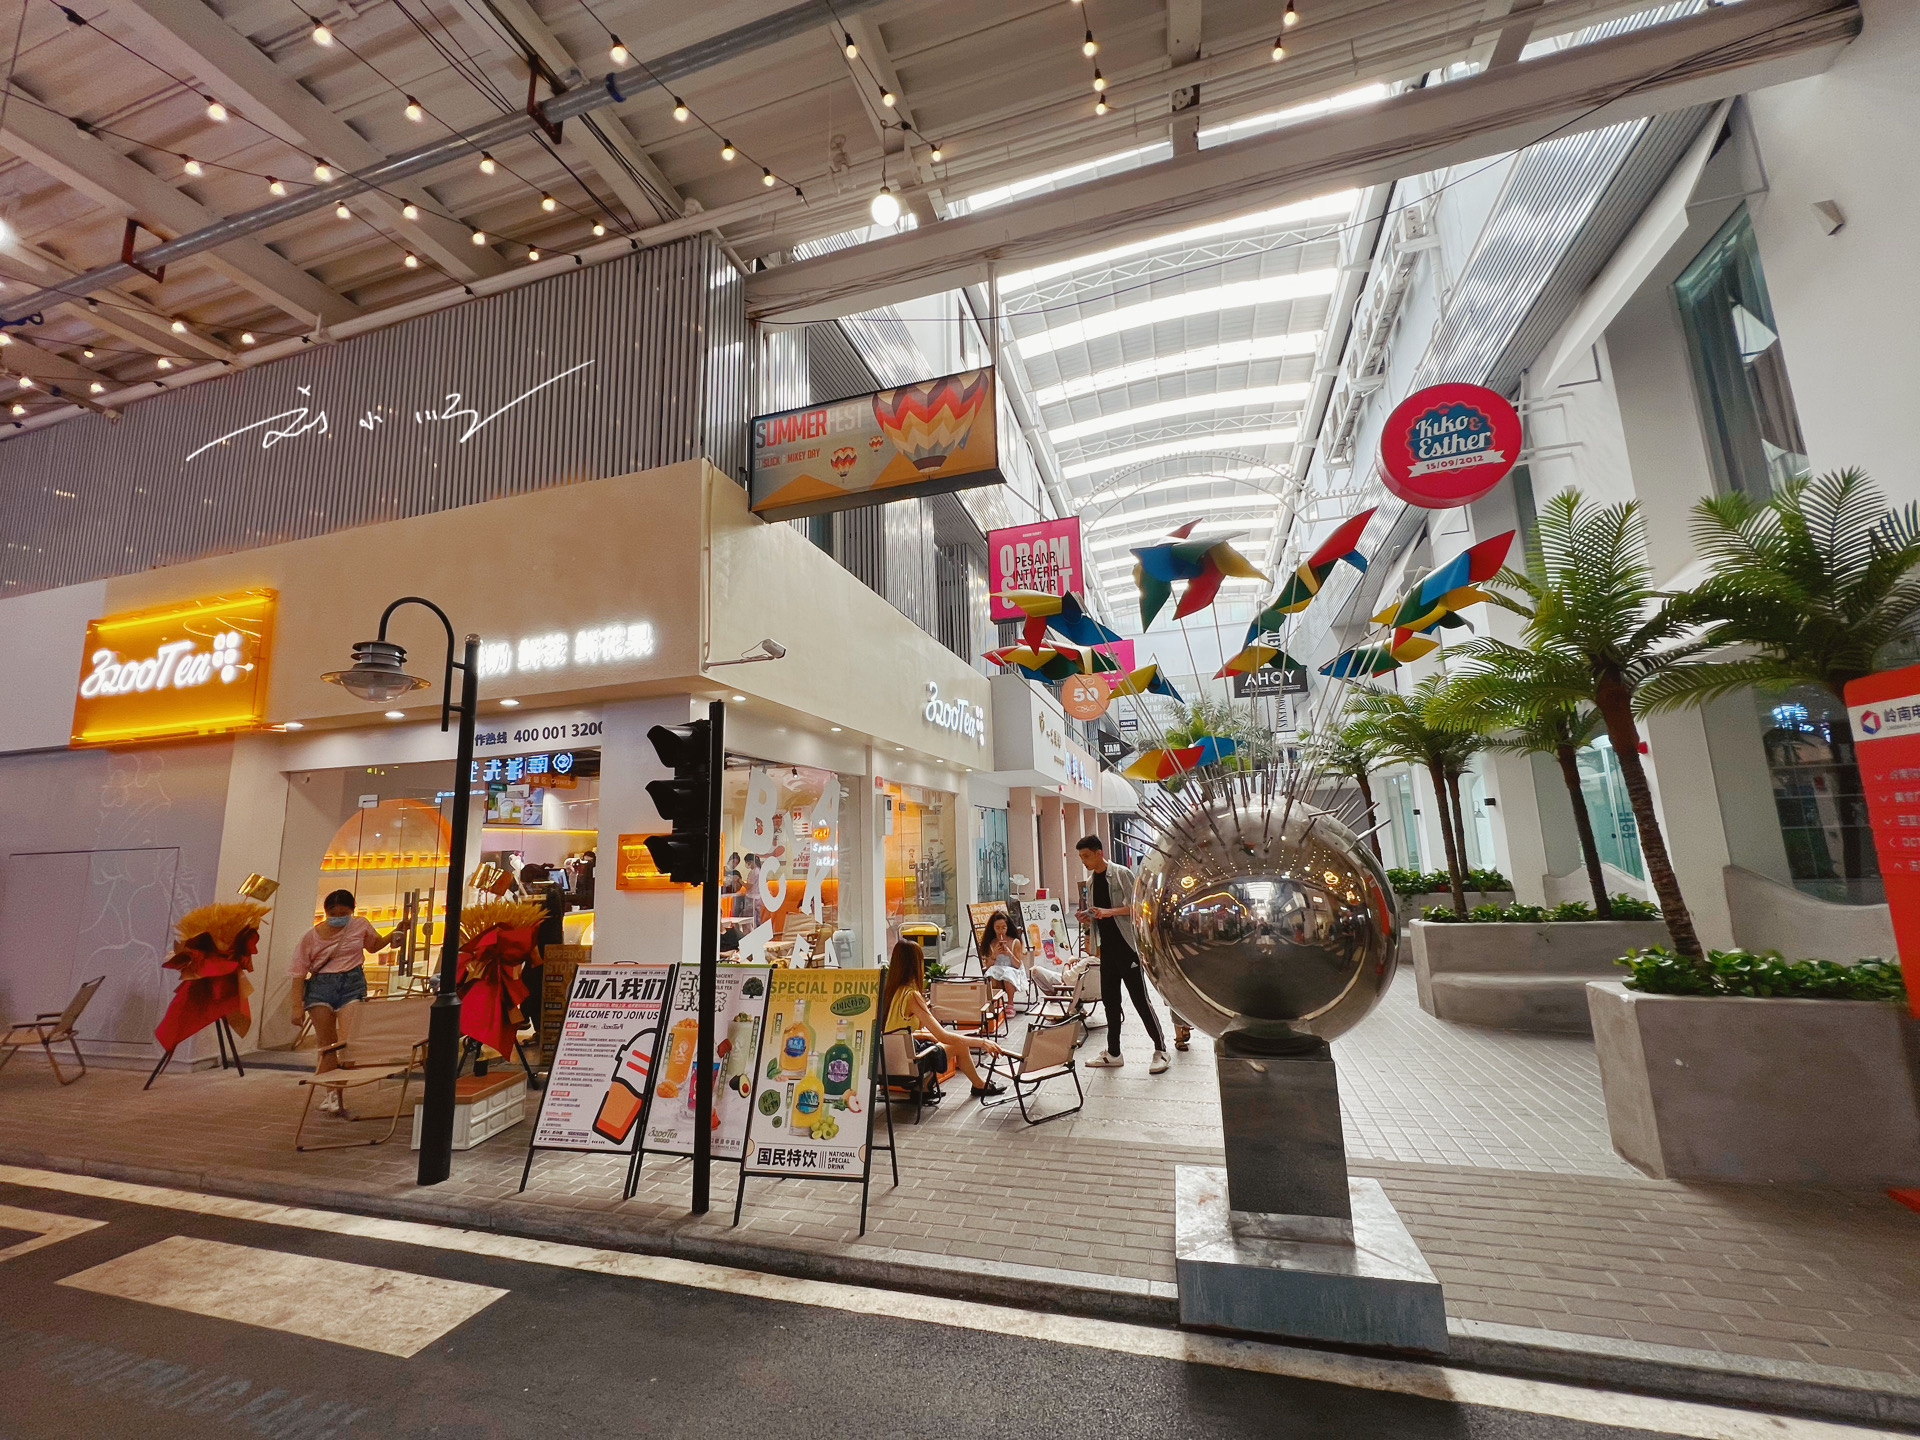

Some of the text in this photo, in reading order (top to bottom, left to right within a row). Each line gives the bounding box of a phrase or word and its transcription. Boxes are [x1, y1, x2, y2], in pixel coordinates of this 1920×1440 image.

[1418, 431, 1492, 459] Esther
[787, 451, 806, 463] MIKEY
[807, 448, 821, 459] DAY
[1426, 455, 1484, 470] 15/09/2012
[1015, 551, 1056, 567] PESANR
[1245, 670, 1296, 687] AHOY
[1073, 687, 1099, 702] 50
[513, 728, 539, 743] 400
[542, 725, 566, 740] 001
[573, 977, 667, 1001] 加入我们
[770, 981, 879, 995] SPECIAL DRINK
[568, 1009, 660, 1020] WELCOME TO JOIN US
[757, 1147, 818, 1169] 国民特饮
